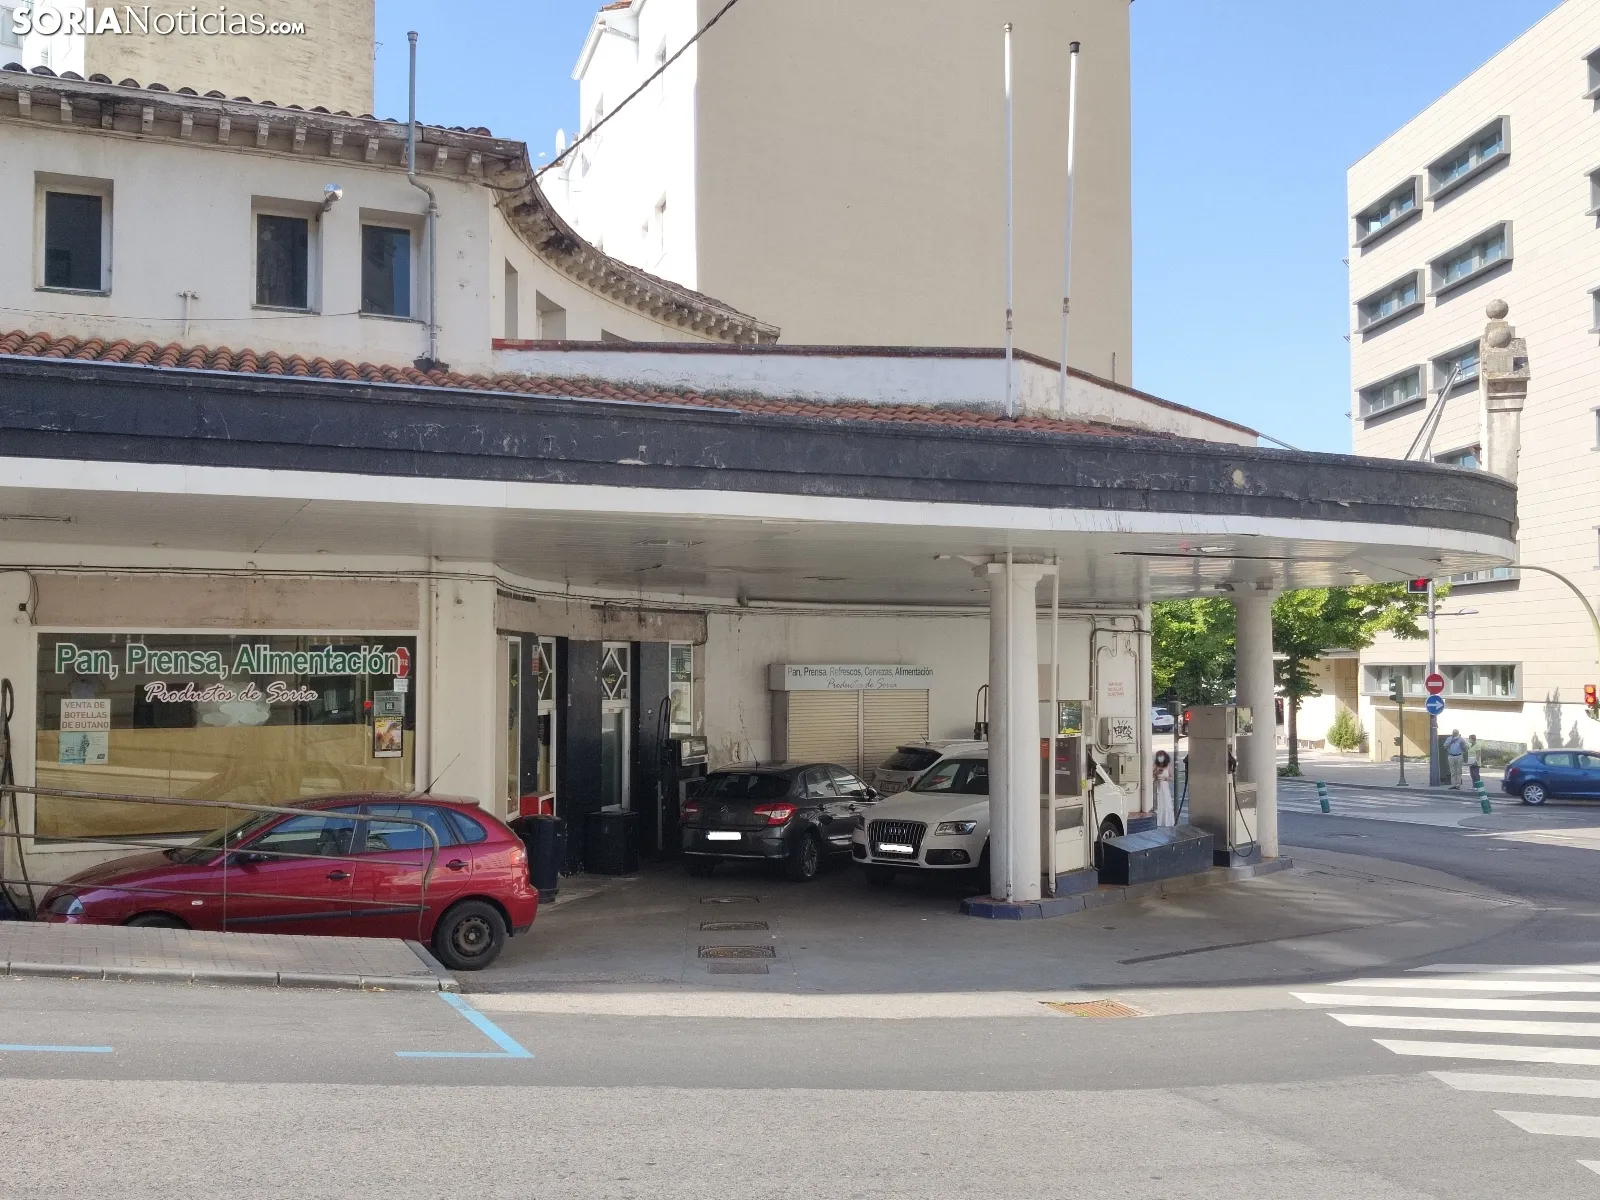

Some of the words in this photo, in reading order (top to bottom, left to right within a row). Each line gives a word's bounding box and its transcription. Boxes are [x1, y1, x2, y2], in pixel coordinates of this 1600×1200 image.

[55, 642, 119, 680] Pan,
[126, 643, 228, 680] Prensa,
[232, 644, 401, 675] Alimentación
[829, 667, 863, 678] Refrescos,
[864, 667, 894, 678] Cervezas,
[894, 667, 934, 677] Alimentación
[865, 679, 874, 689] de
[876, 679, 898, 690] Soria
[144, 681, 236, 703] Productos
[239, 682, 262, 702] de
[266, 681, 319, 704] Soria
[65, 701, 92, 709] VENTA
[94, 701, 105, 709] DE
[64, 711, 107, 719] BOTELLAS
[62, 721, 73, 729] DE
[75, 721, 109, 729] BUTANO
